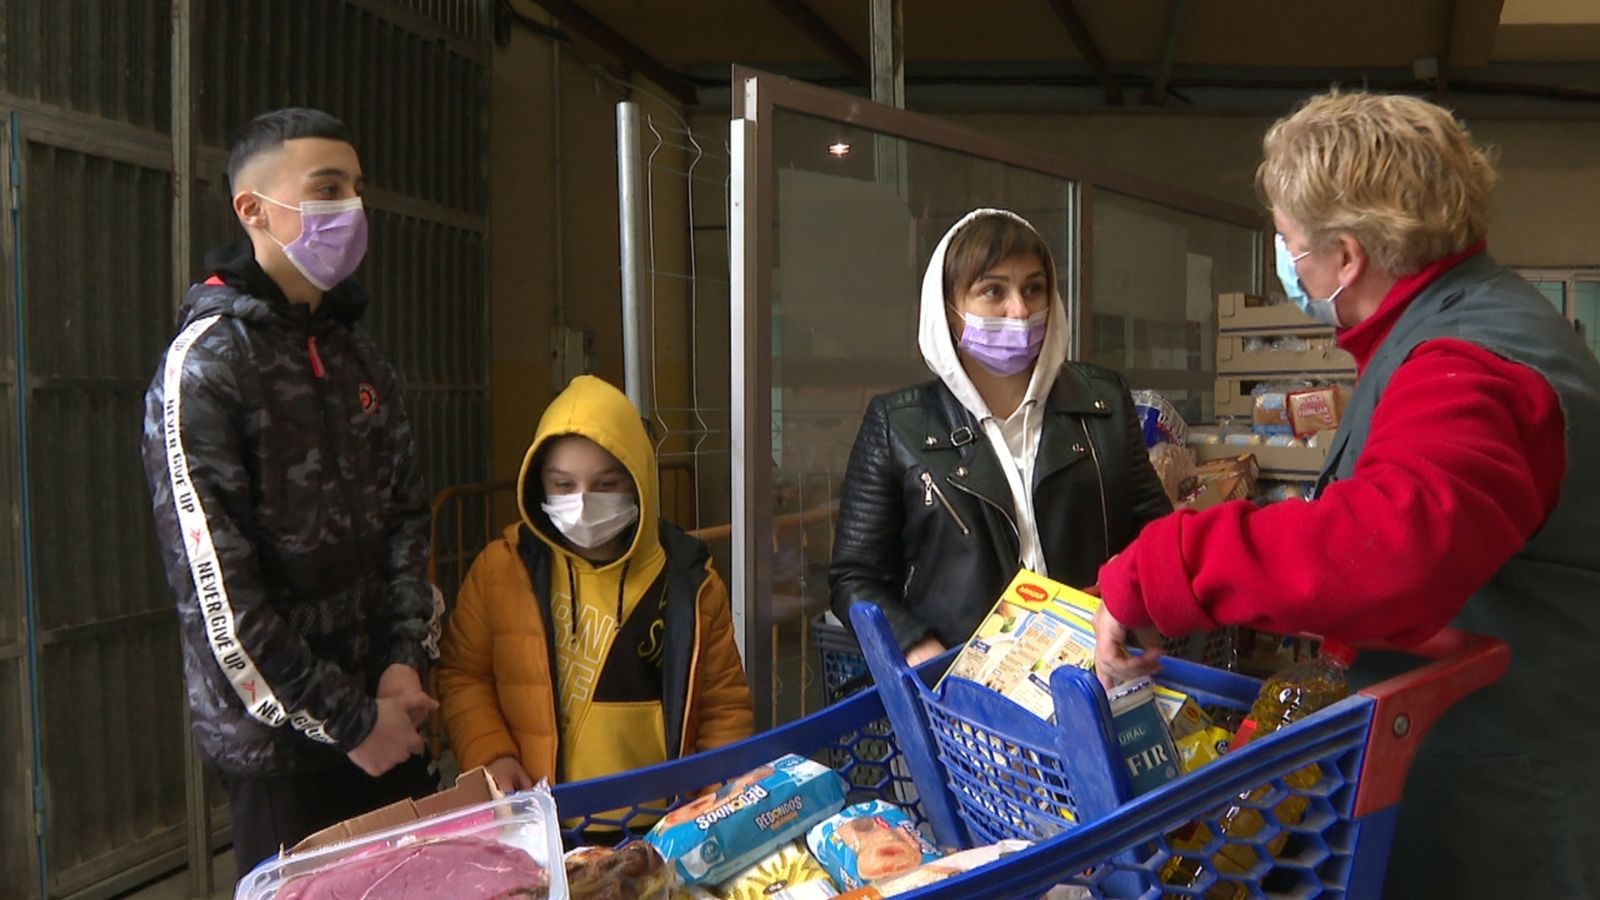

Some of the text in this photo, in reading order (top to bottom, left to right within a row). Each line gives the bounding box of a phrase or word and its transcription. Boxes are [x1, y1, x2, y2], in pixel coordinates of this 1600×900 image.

[166, 398, 196, 513] NEVER GIVE UP
[197, 561, 247, 671] NEVER GIVE UP
[695, 784, 769, 831] REDONDOS
[754, 795, 803, 831] REDONDOS
